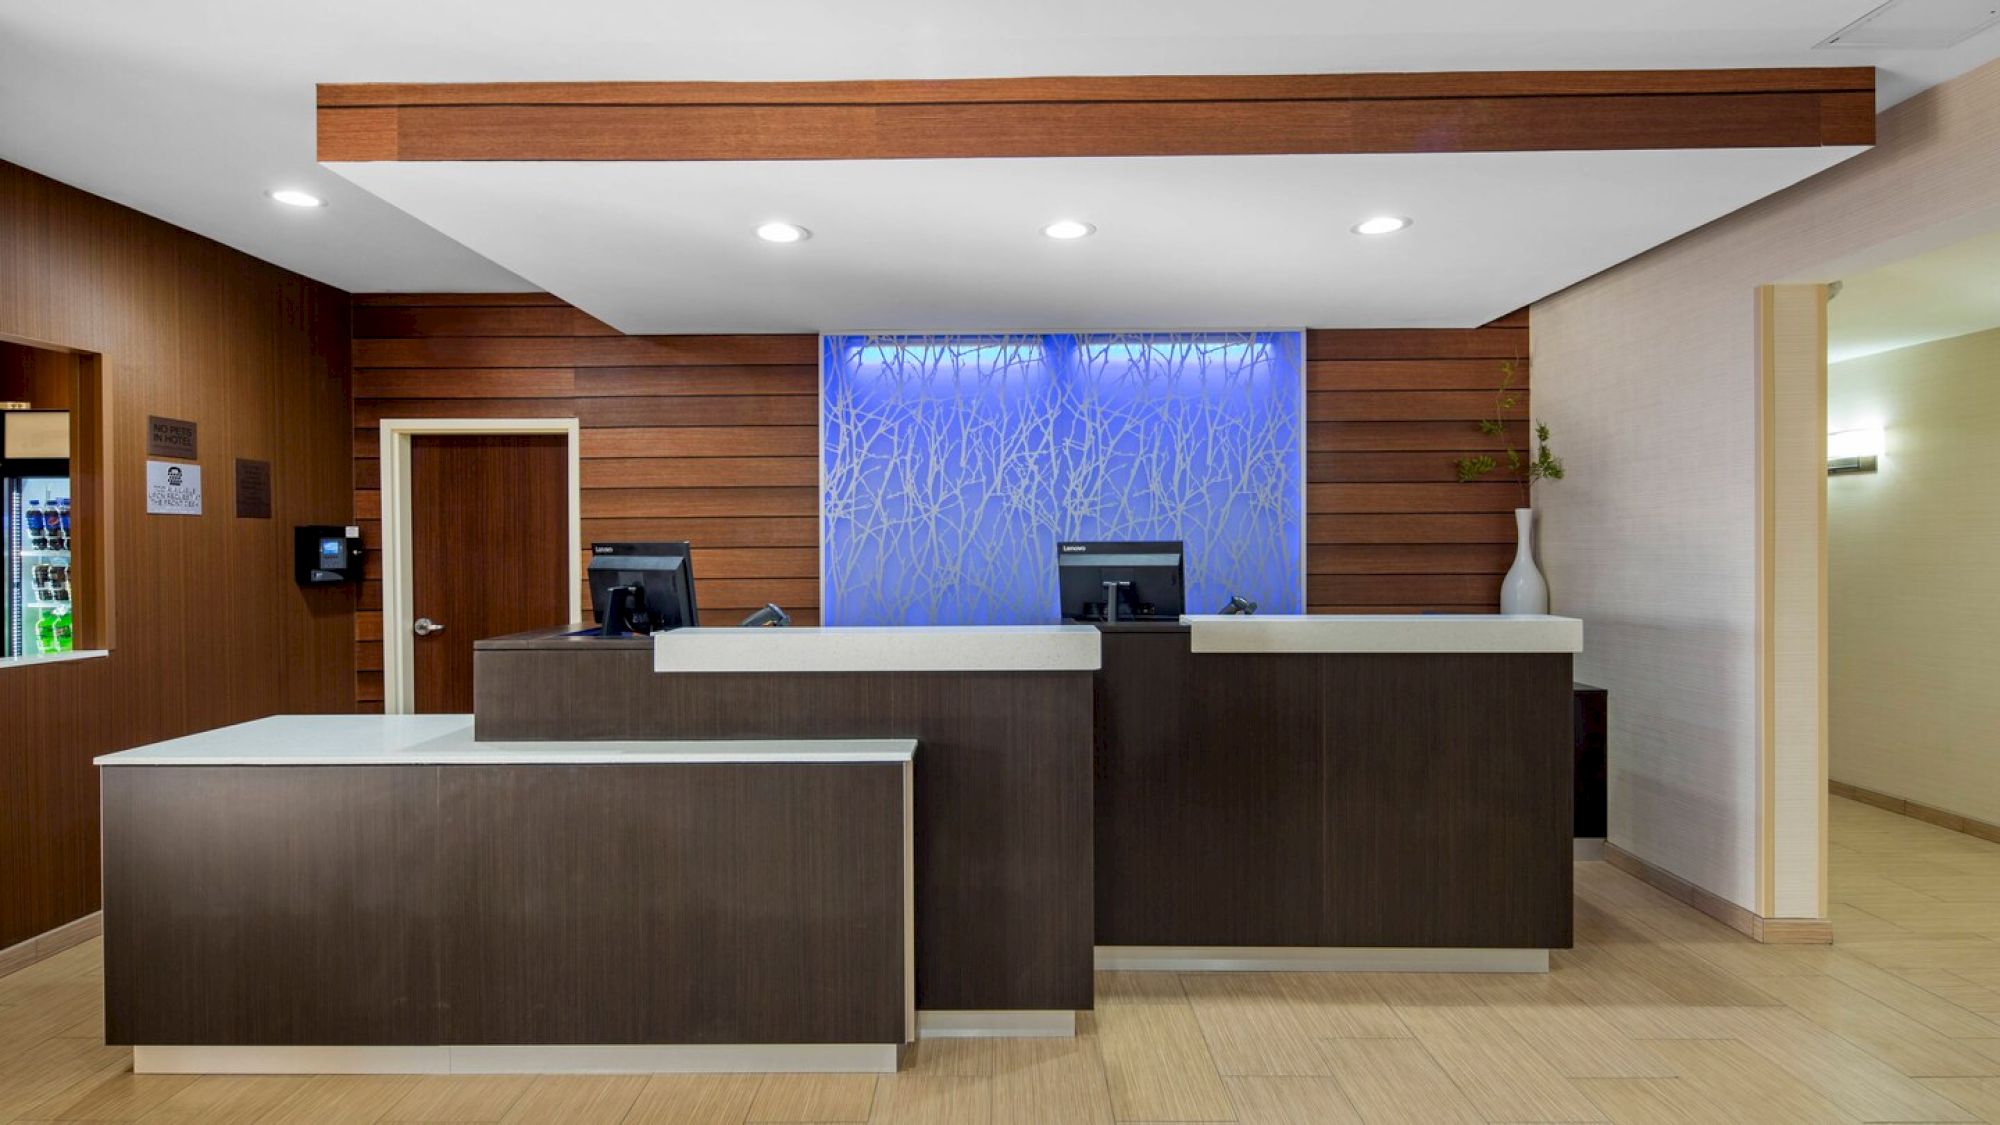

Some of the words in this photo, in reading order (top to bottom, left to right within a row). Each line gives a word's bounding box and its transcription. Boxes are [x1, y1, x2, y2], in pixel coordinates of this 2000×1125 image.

[153, 424, 168, 433] NO
[170, 426, 192, 437] PETS
[153, 433, 163, 442] IN
[165, 435, 193, 446] HOTEL
